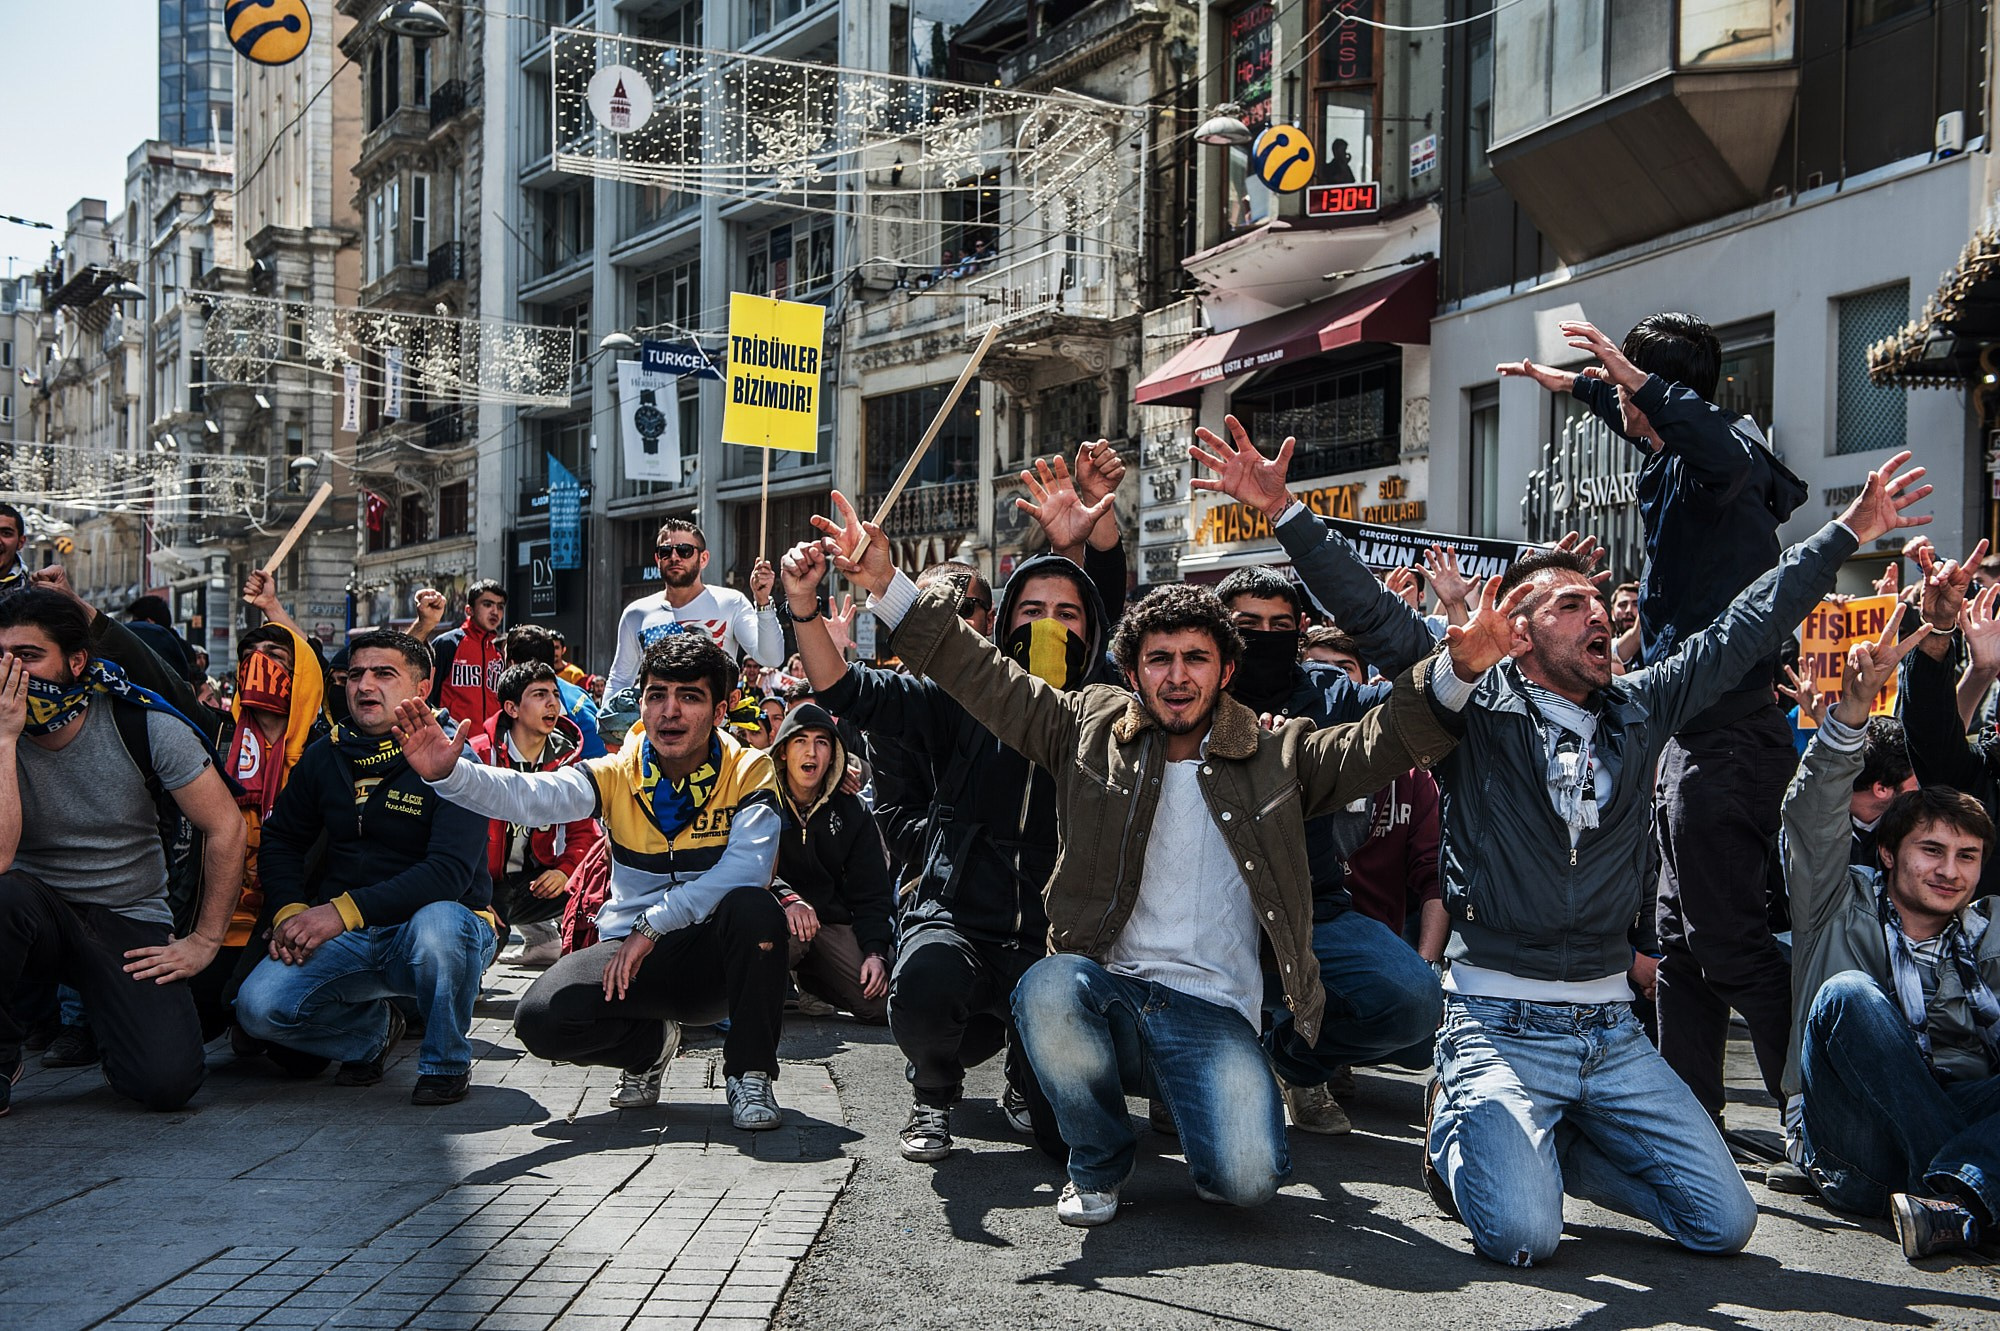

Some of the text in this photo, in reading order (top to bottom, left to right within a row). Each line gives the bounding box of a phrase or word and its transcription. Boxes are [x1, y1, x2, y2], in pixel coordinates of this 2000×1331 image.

[1321, 187, 1373, 212] 1304
[731, 333, 818, 374] TRİBÜNLER
[732, 372, 812, 413] BİZİMDİR!
[1378, 475, 1403, 500] SÜT
[1212, 502, 1278, 546] HASA
[1400, 535, 1412, 545] OL
[452, 662, 482, 687] RUS
